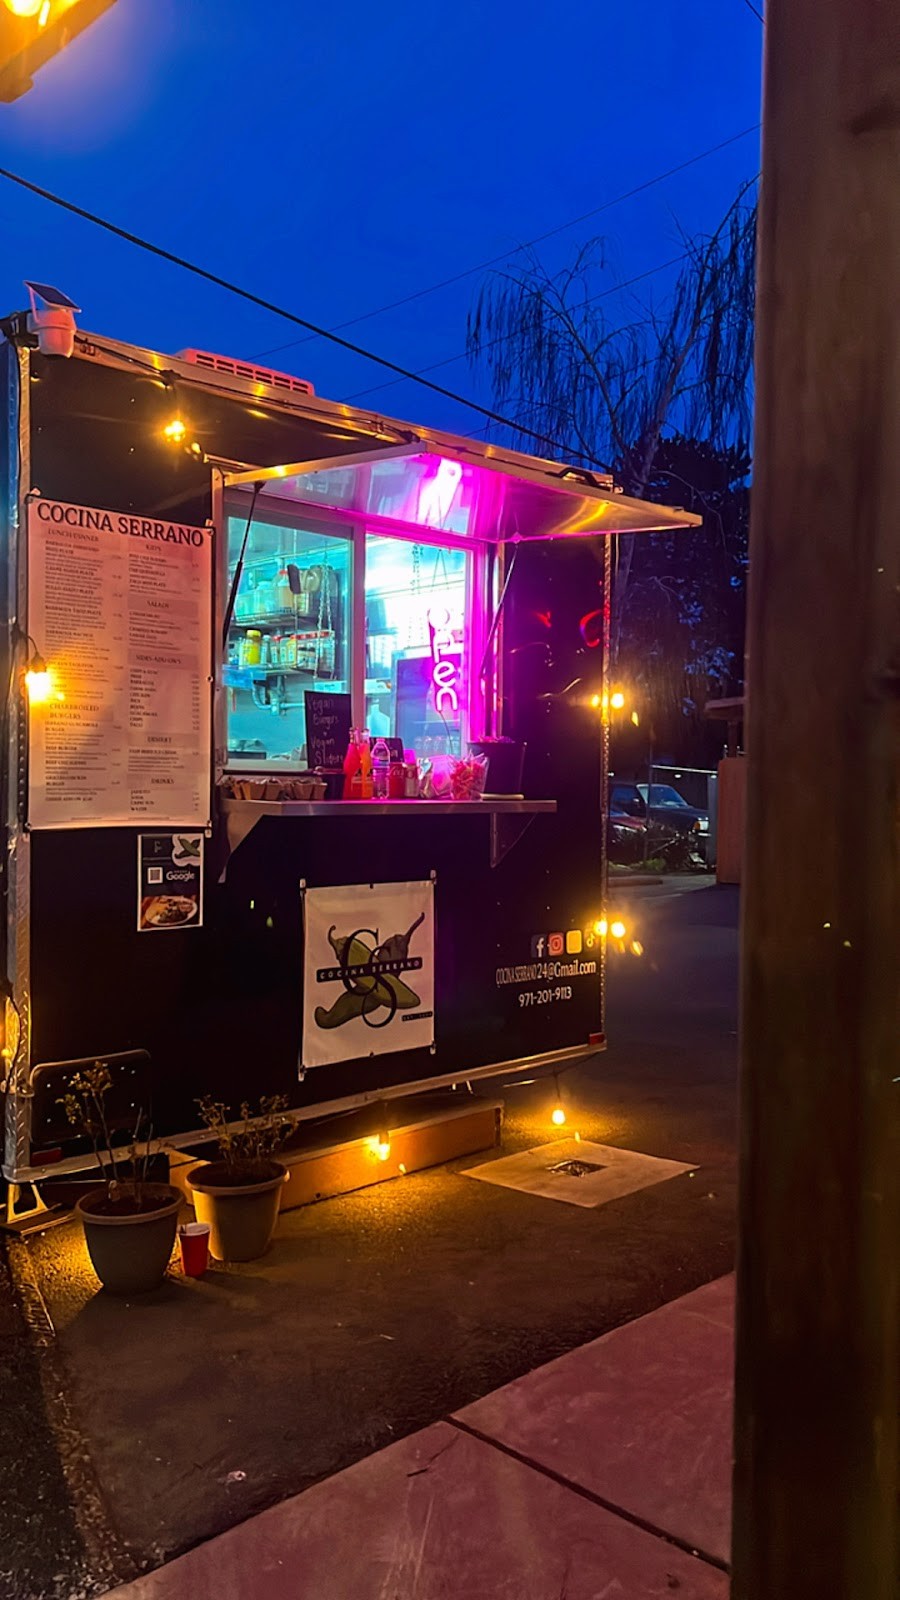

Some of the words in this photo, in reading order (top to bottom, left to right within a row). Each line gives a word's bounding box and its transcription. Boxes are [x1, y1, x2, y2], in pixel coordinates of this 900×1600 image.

[37, 502, 114, 533] COCINA
[118, 516, 204, 547] SERRANO
[165, 870, 196, 882] Google
[319, 967, 365, 980] COCINA
[371, 960, 420, 974] SERRANO
[518, 985, 573, 1008] 971-201-9113
